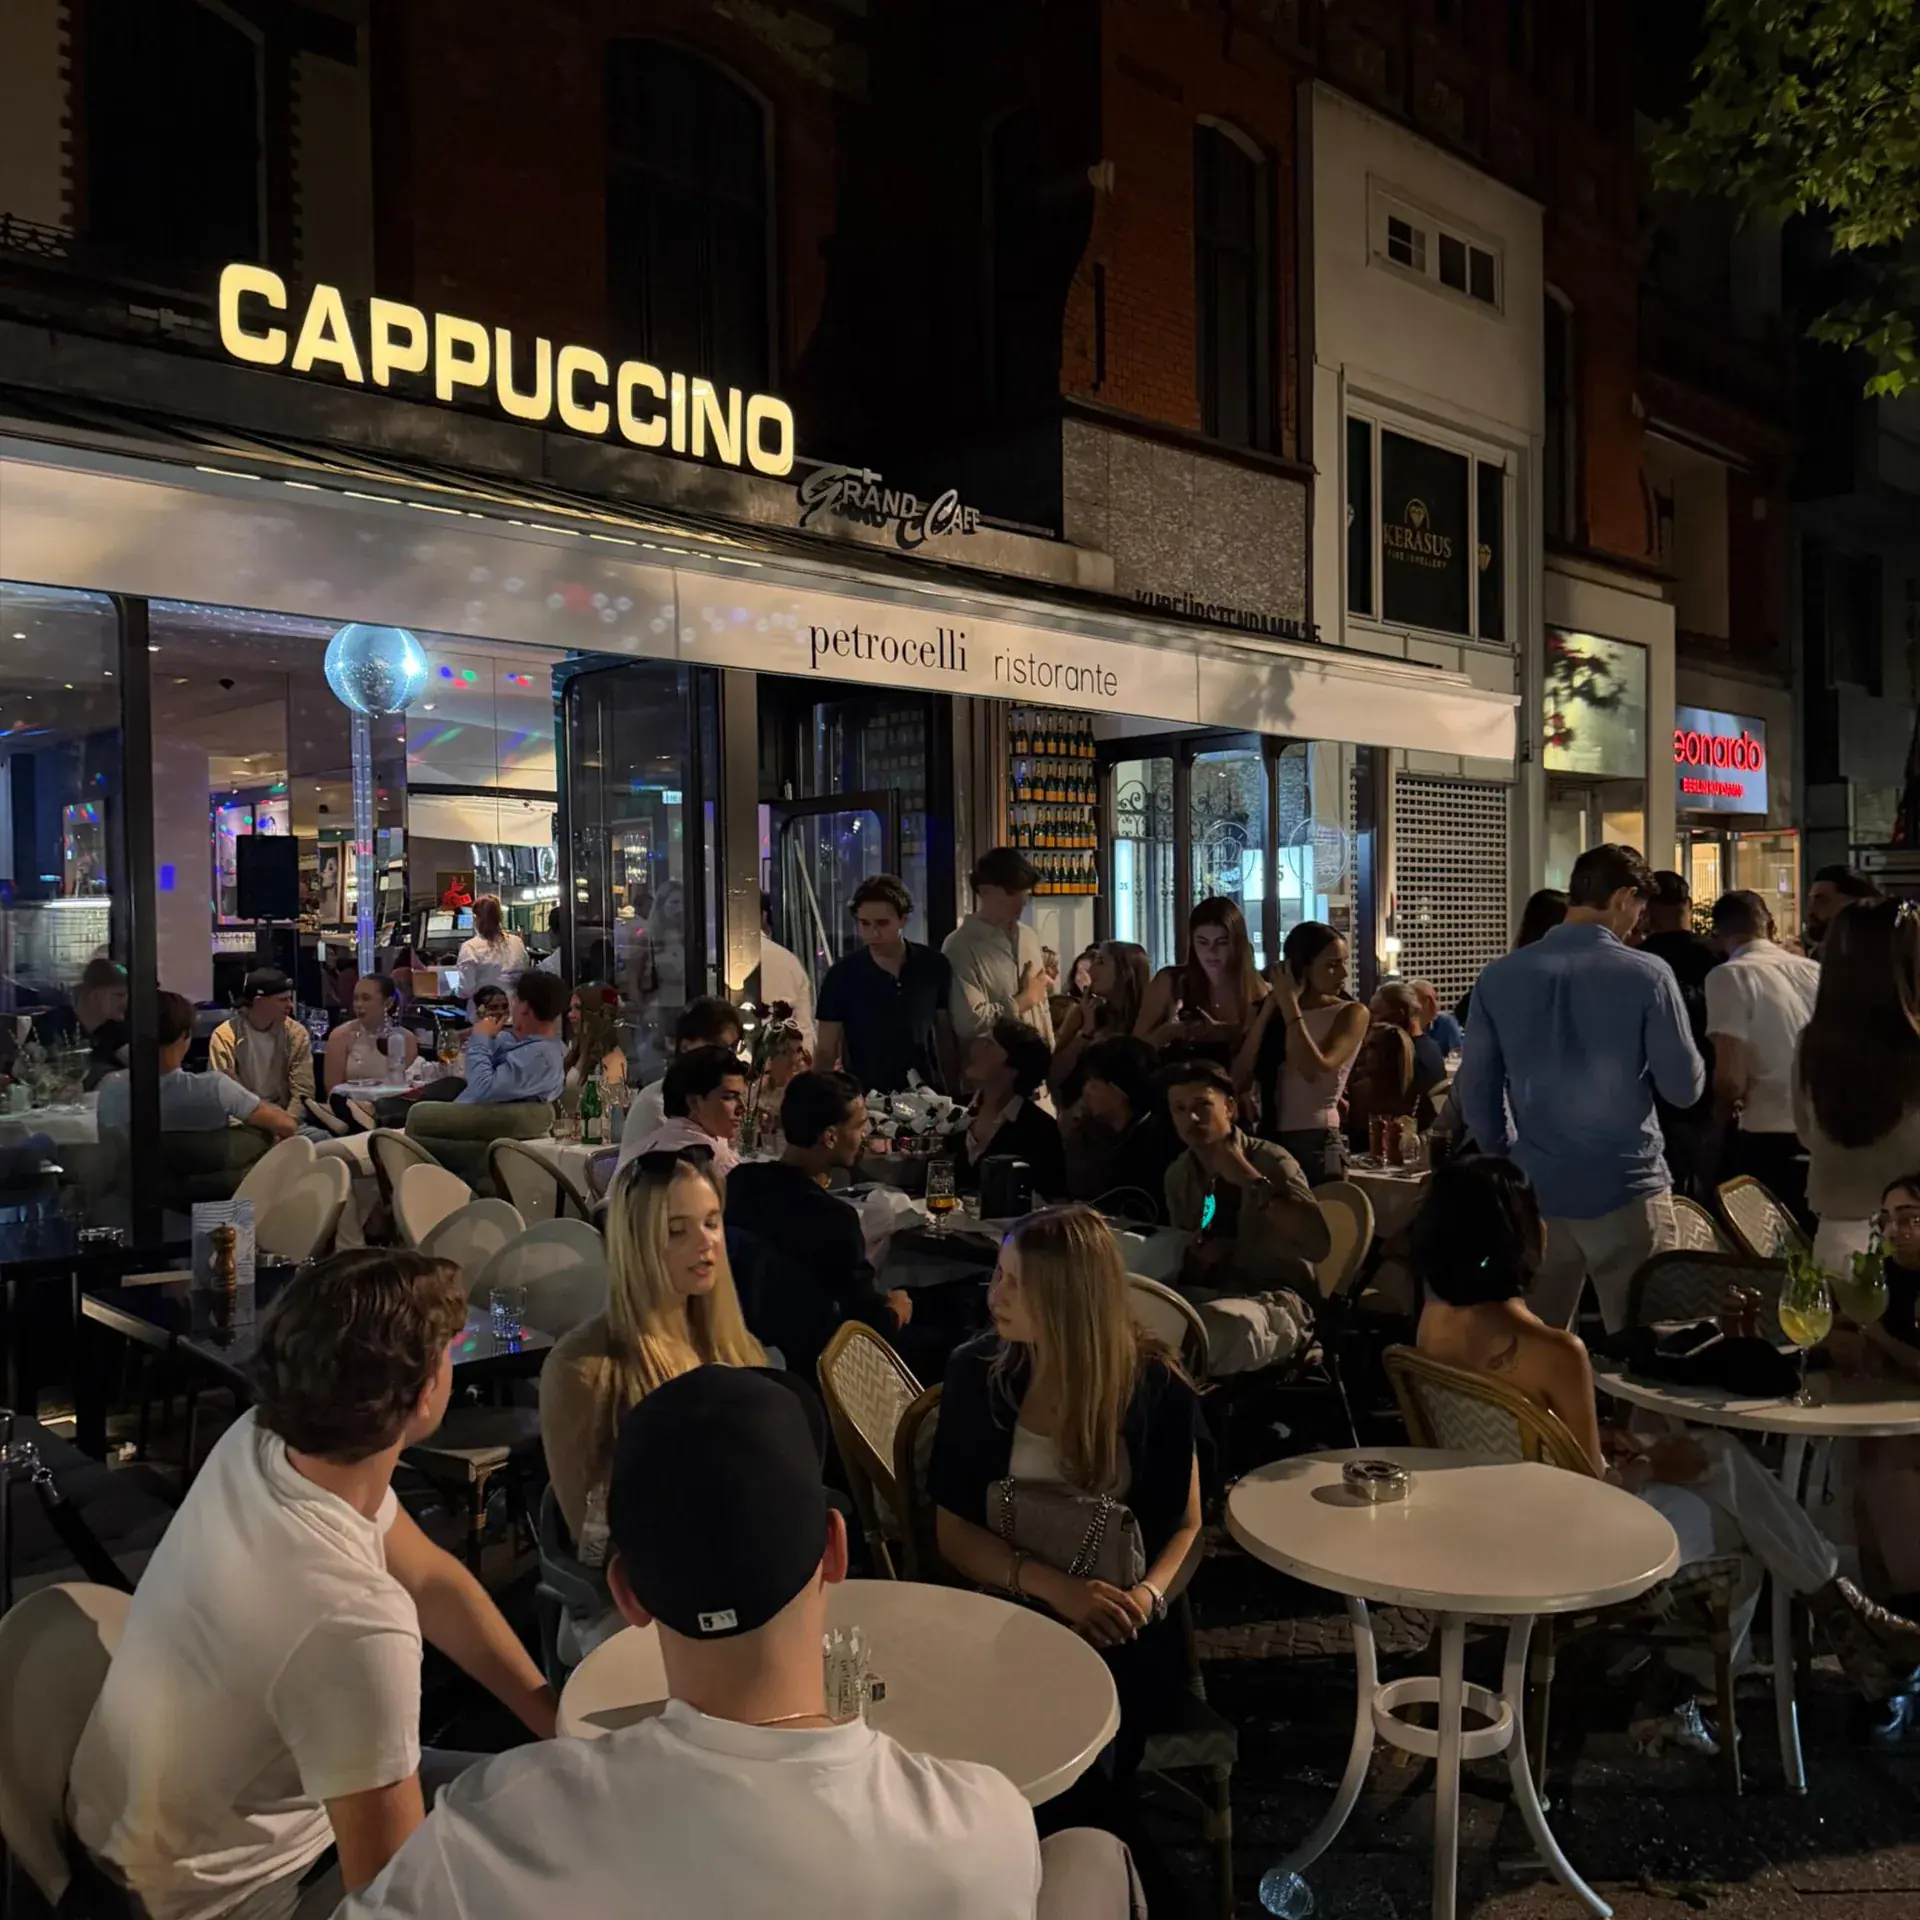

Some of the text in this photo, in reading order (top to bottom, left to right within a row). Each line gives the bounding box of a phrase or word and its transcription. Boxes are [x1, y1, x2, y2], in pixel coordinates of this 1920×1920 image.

[218, 263, 795, 476] CAPPUCCINO
[801, 466, 919, 524] GRAND
[1383, 522, 1453, 559] KERASUS
[807, 623, 1119, 697] petrocelli ristorante
[1674, 729, 1763, 772] eonardo
